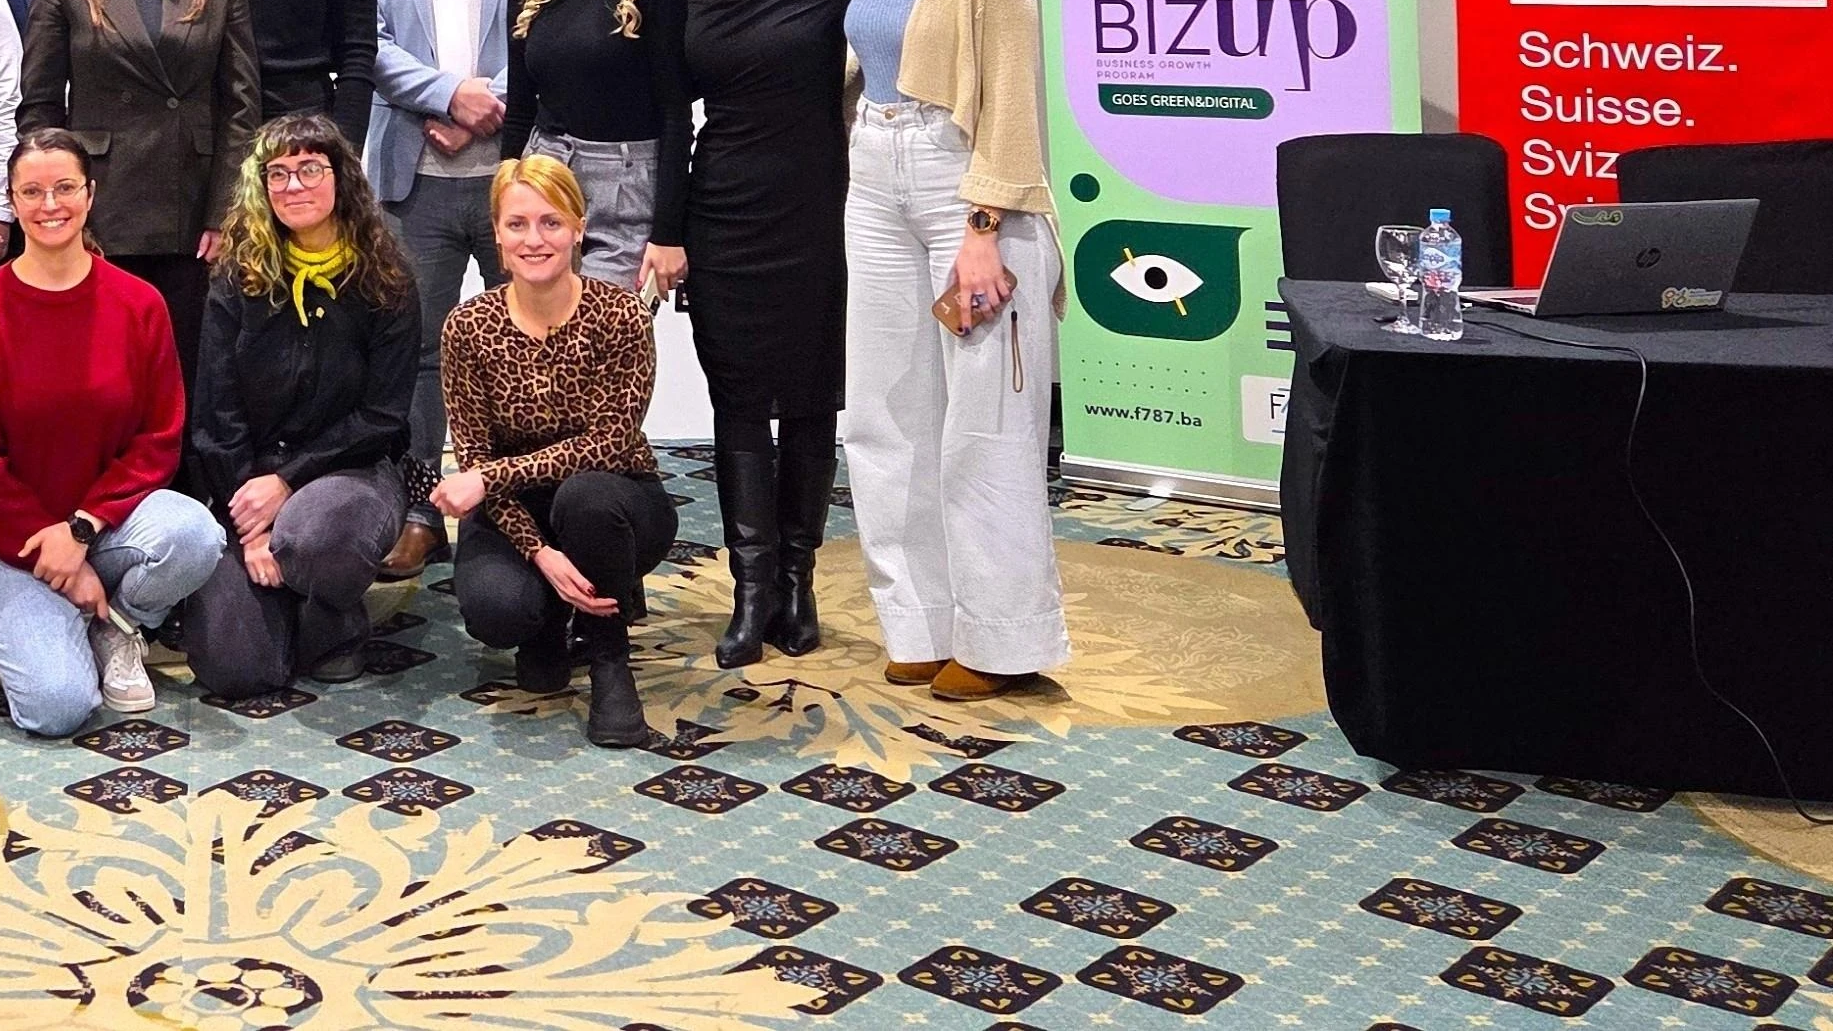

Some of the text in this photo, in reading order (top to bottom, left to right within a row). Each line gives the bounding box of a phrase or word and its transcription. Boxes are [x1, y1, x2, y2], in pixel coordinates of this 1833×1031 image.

[1518, 30, 1738, 72] Schweiz.
[1096, 59, 1212, 70] BUSINESS GROWTH
[1096, 70, 1156, 80] PROGRAM
[1111, 93, 1258, 110] GOES GREEN&DIGITAL
[1520, 84, 1695, 127] Suisse.
[1521, 138, 1619, 180] Sviz
[1084, 403, 1203, 428] www.f787.ba
